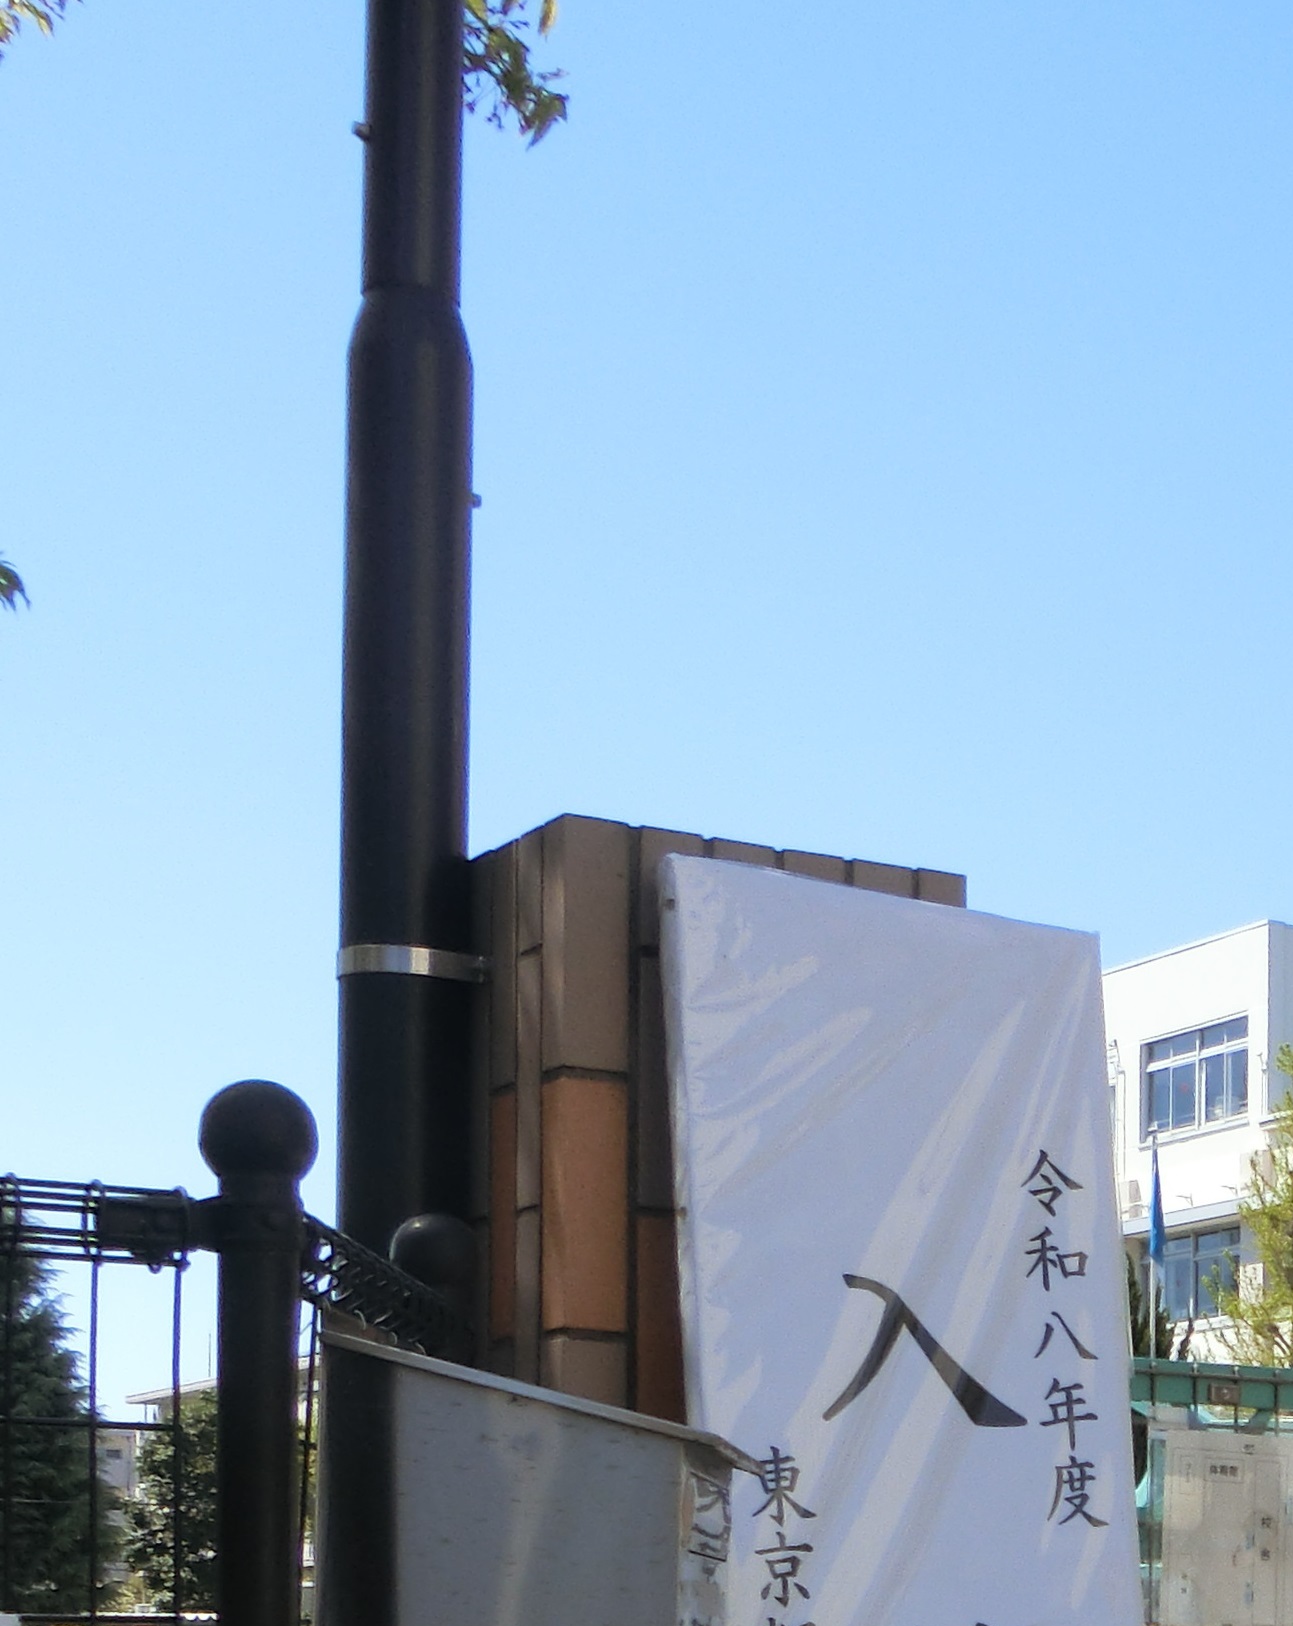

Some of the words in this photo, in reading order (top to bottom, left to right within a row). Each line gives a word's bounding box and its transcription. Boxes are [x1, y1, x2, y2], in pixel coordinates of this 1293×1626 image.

[1020, 1148, 1108, 1530] 令和八年度
